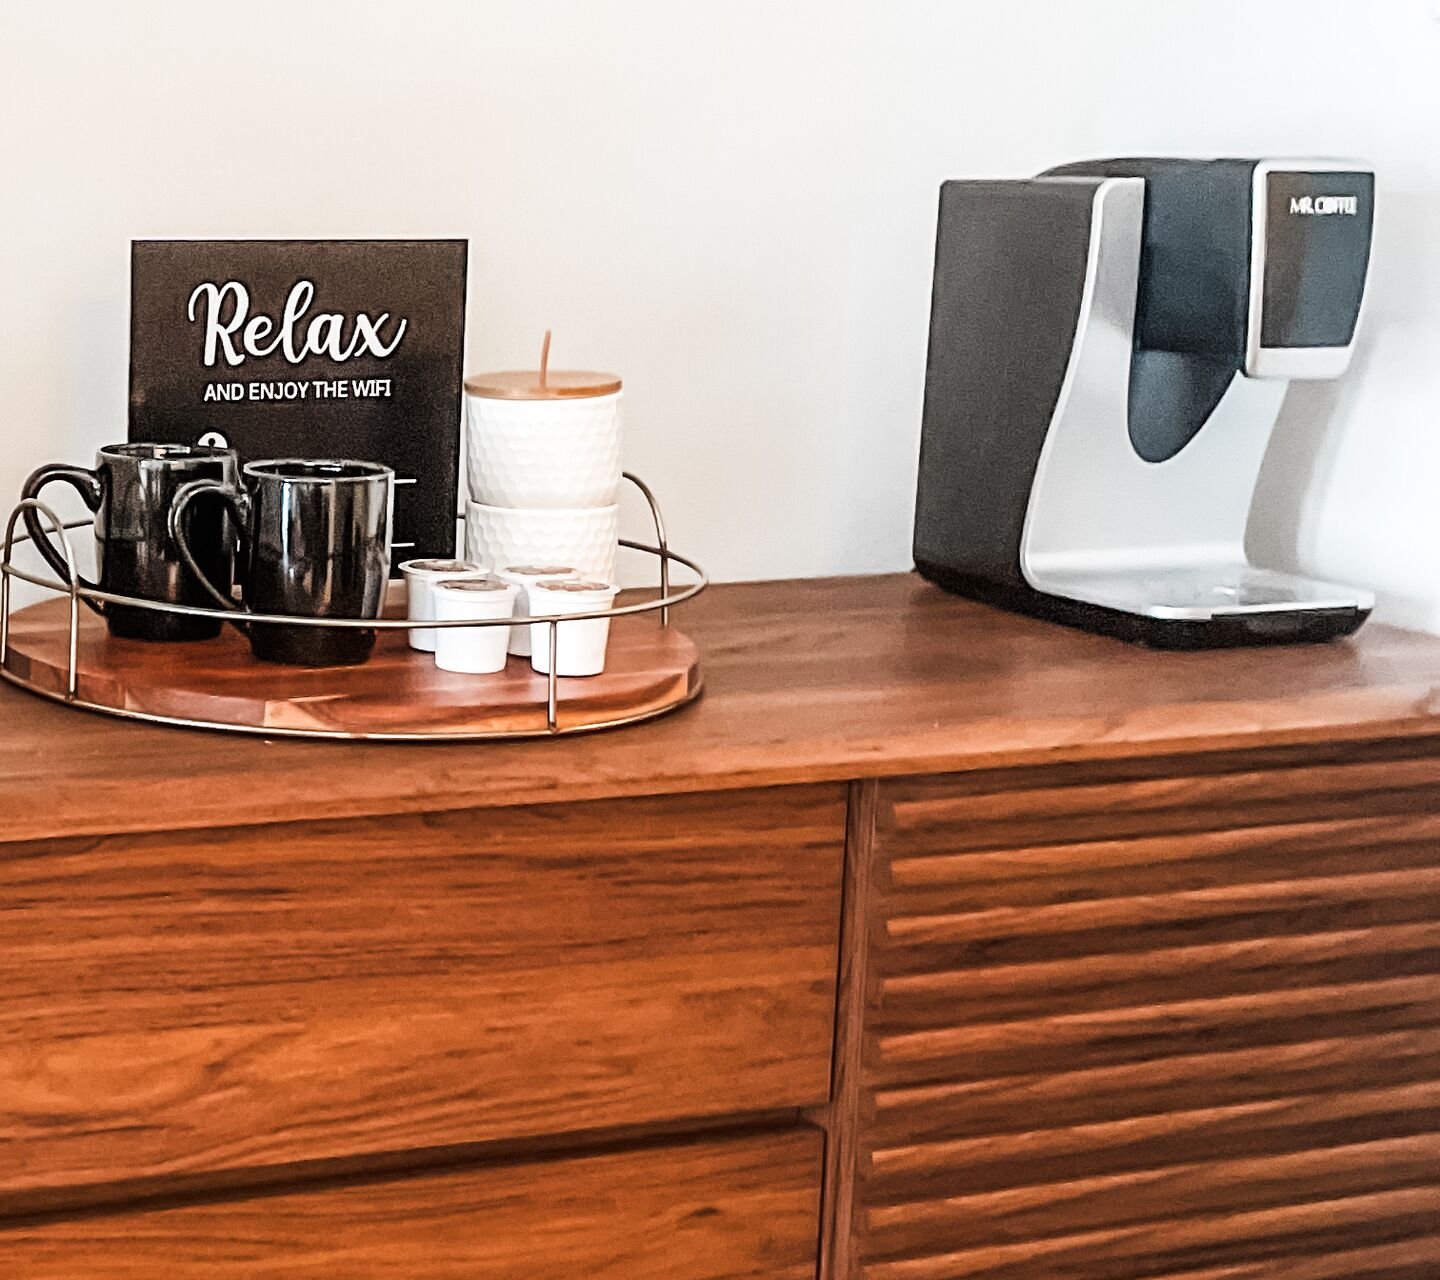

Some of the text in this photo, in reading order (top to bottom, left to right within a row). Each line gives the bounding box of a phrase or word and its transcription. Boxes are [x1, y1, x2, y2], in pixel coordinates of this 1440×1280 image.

[187, 280, 407, 367] Relax
[203, 379, 392, 402] AND ENJOY THE WIFI
